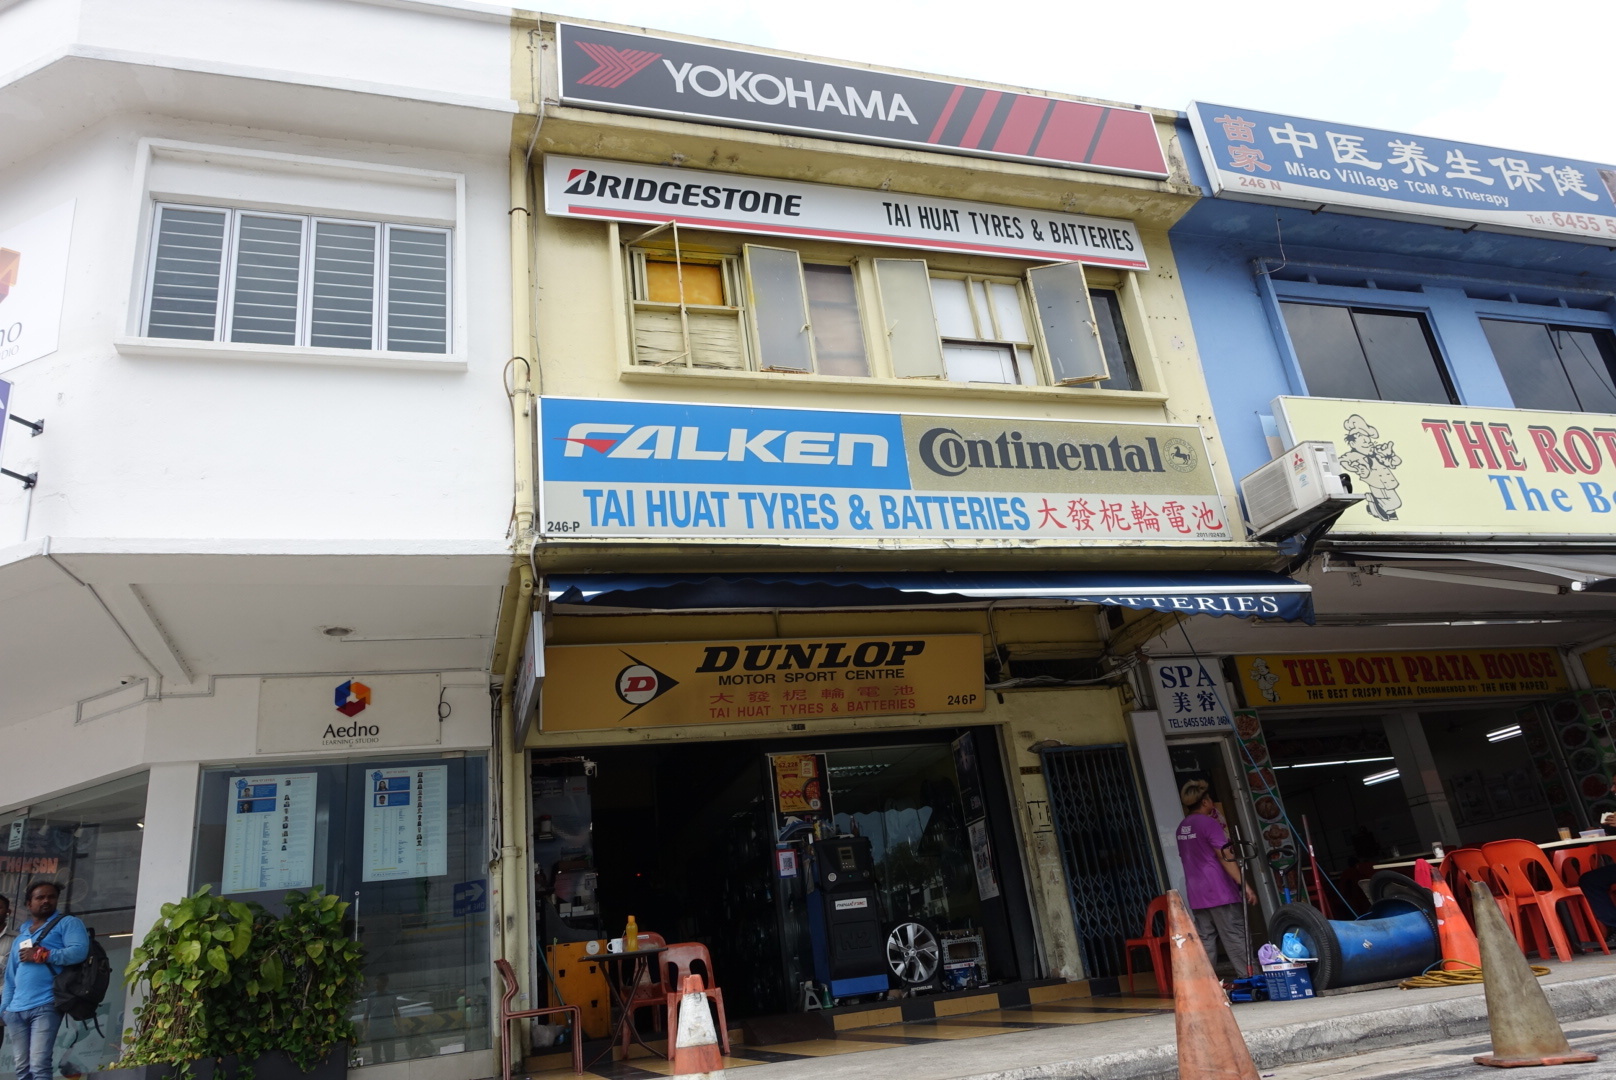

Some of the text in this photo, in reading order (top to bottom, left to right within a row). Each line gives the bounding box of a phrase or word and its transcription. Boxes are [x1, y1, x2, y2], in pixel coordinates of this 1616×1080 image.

[662, 59, 919, 125] YOKOHAMA
[1214, 114, 1272, 173] 苗家
[1268, 122, 1599, 201] 中医养生保健
[563, 168, 802, 217] BRIDGESTONE
[1238, 177, 1281, 191] 246 N
[1284, 160, 1510, 208] Miao Village TCM & Therapy
[882, 202, 1135, 252] TAI HUAT TYRES & BATTERIES
[1552, 212, 1601, 232] 6455
[562, 422, 890, 468] FALKEN
[918, 427, 1166, 477] Continental
[1421, 418, 1528, 472] THE
[1488, 474, 1616, 514] The B
[582, 489, 1031, 531] TAI HUAT TYRES & BATTERIES
[547, 521, 581, 533] 246-P
[1101, 595, 1279, 613] ATTERIES
[695, 640, 925, 673] DUNLOP
[1282, 652, 1558, 687] THE ROTI PRATA HOUSE
[718, 668, 905, 686] MOTOR SPORT CENTRE
[1159, 665, 1217, 689] SPA
[1307, 689, 1324, 700] THE
[1327, 688, 1349, 699] BEST
[1352, 687, 1382, 698] CRISPY
[1385, 686, 1413, 697] PRATA
[1480, 683, 1497, 692] THE
[1500, 681, 1517, 691] NEW
[1520, 680, 1549, 690] PAPER)
[709, 699, 916, 719] TAI HUAT TYRES & BATTERIES
[947, 694, 977, 706] 246P
[1172, 690, 1216, 714] 美容
[322, 721, 380, 740] Aedno
[1184, 717, 1200, 728] 6455
[1201, 716, 1216, 727] 5246
[322, 737, 380, 746] LEARNING STUDIO
